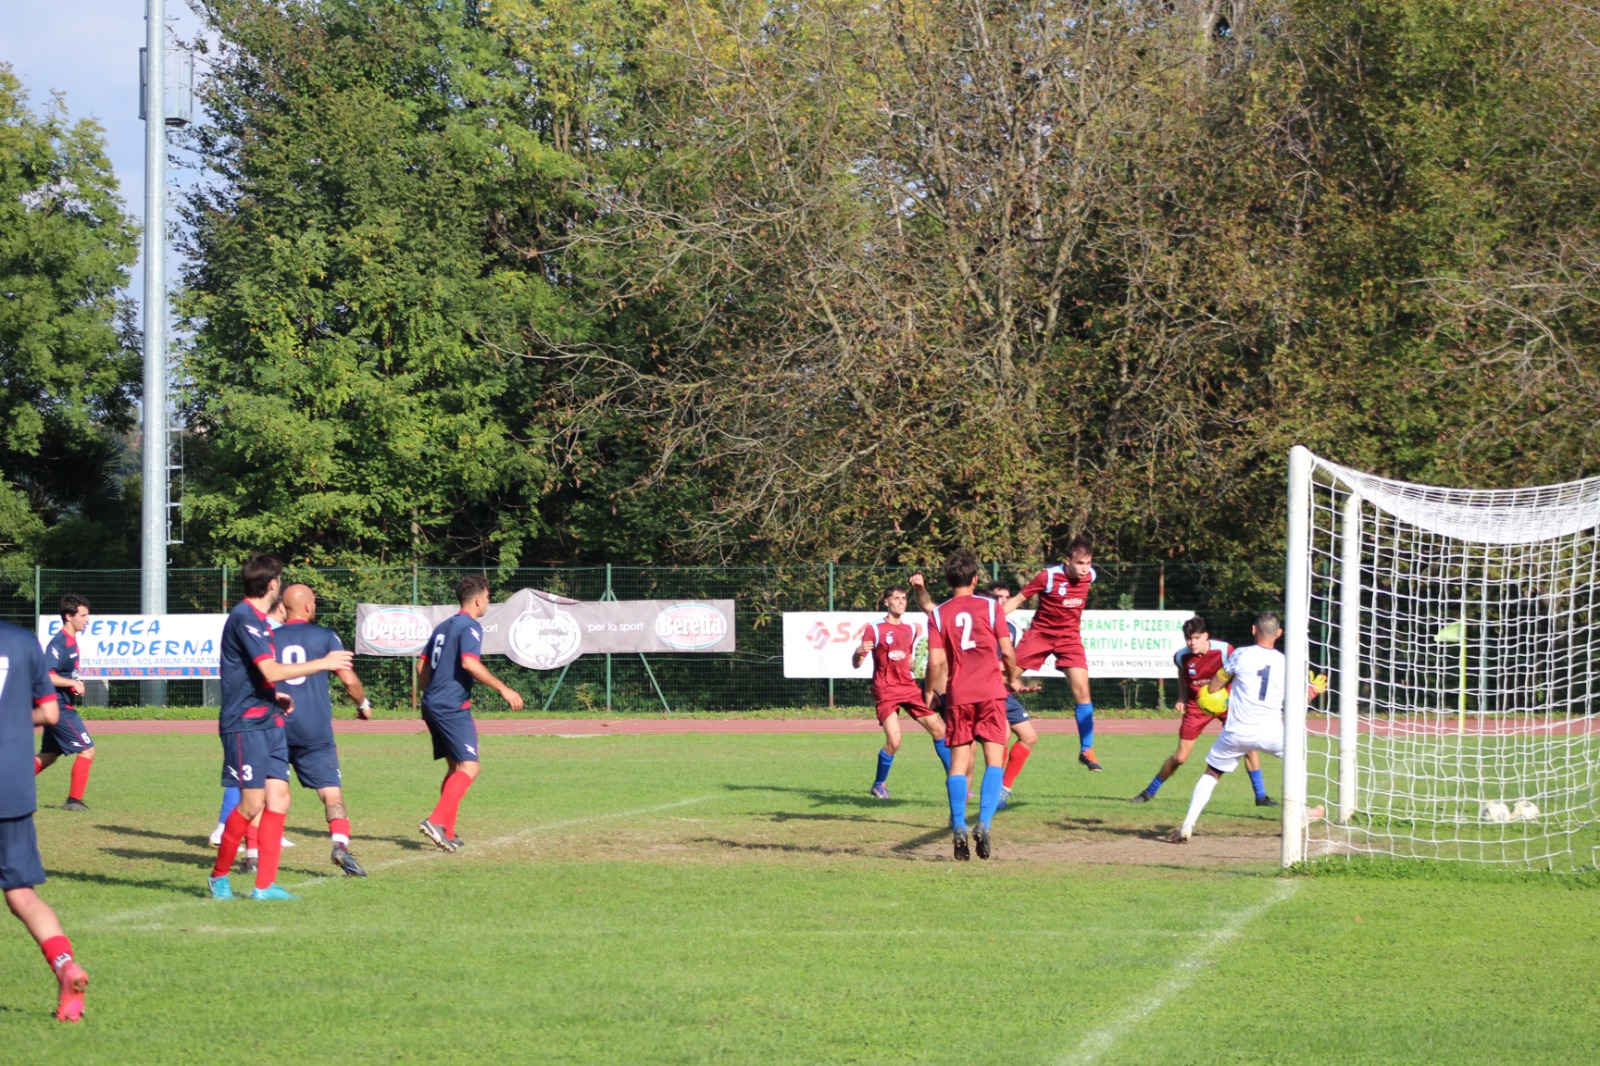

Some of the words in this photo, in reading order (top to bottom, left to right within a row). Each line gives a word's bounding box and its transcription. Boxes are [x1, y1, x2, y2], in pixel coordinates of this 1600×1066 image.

[48, 619, 160, 637] EETICA
[365, 619, 428, 640] Beretta
[588, 623, 605, 633] per
[608, 622, 617, 631] lo
[619, 622, 644, 632] sport
[659, 614, 724, 637] Beretta
[955, 611, 977, 651] 2
[1080, 619, 1124, 631] ORANTE
[1133, 619, 1183, 631] PIZZERIA
[97, 639, 214, 656] MODERNA
[430, 633, 445, 669] 6
[1083, 637, 1122, 649] ERITIVI
[1130, 637, 1171, 650] EVENTI
[1257, 665, 1271, 701] 1
[81, 732, 92, 744] 5
[242, 764, 253, 781] 3
